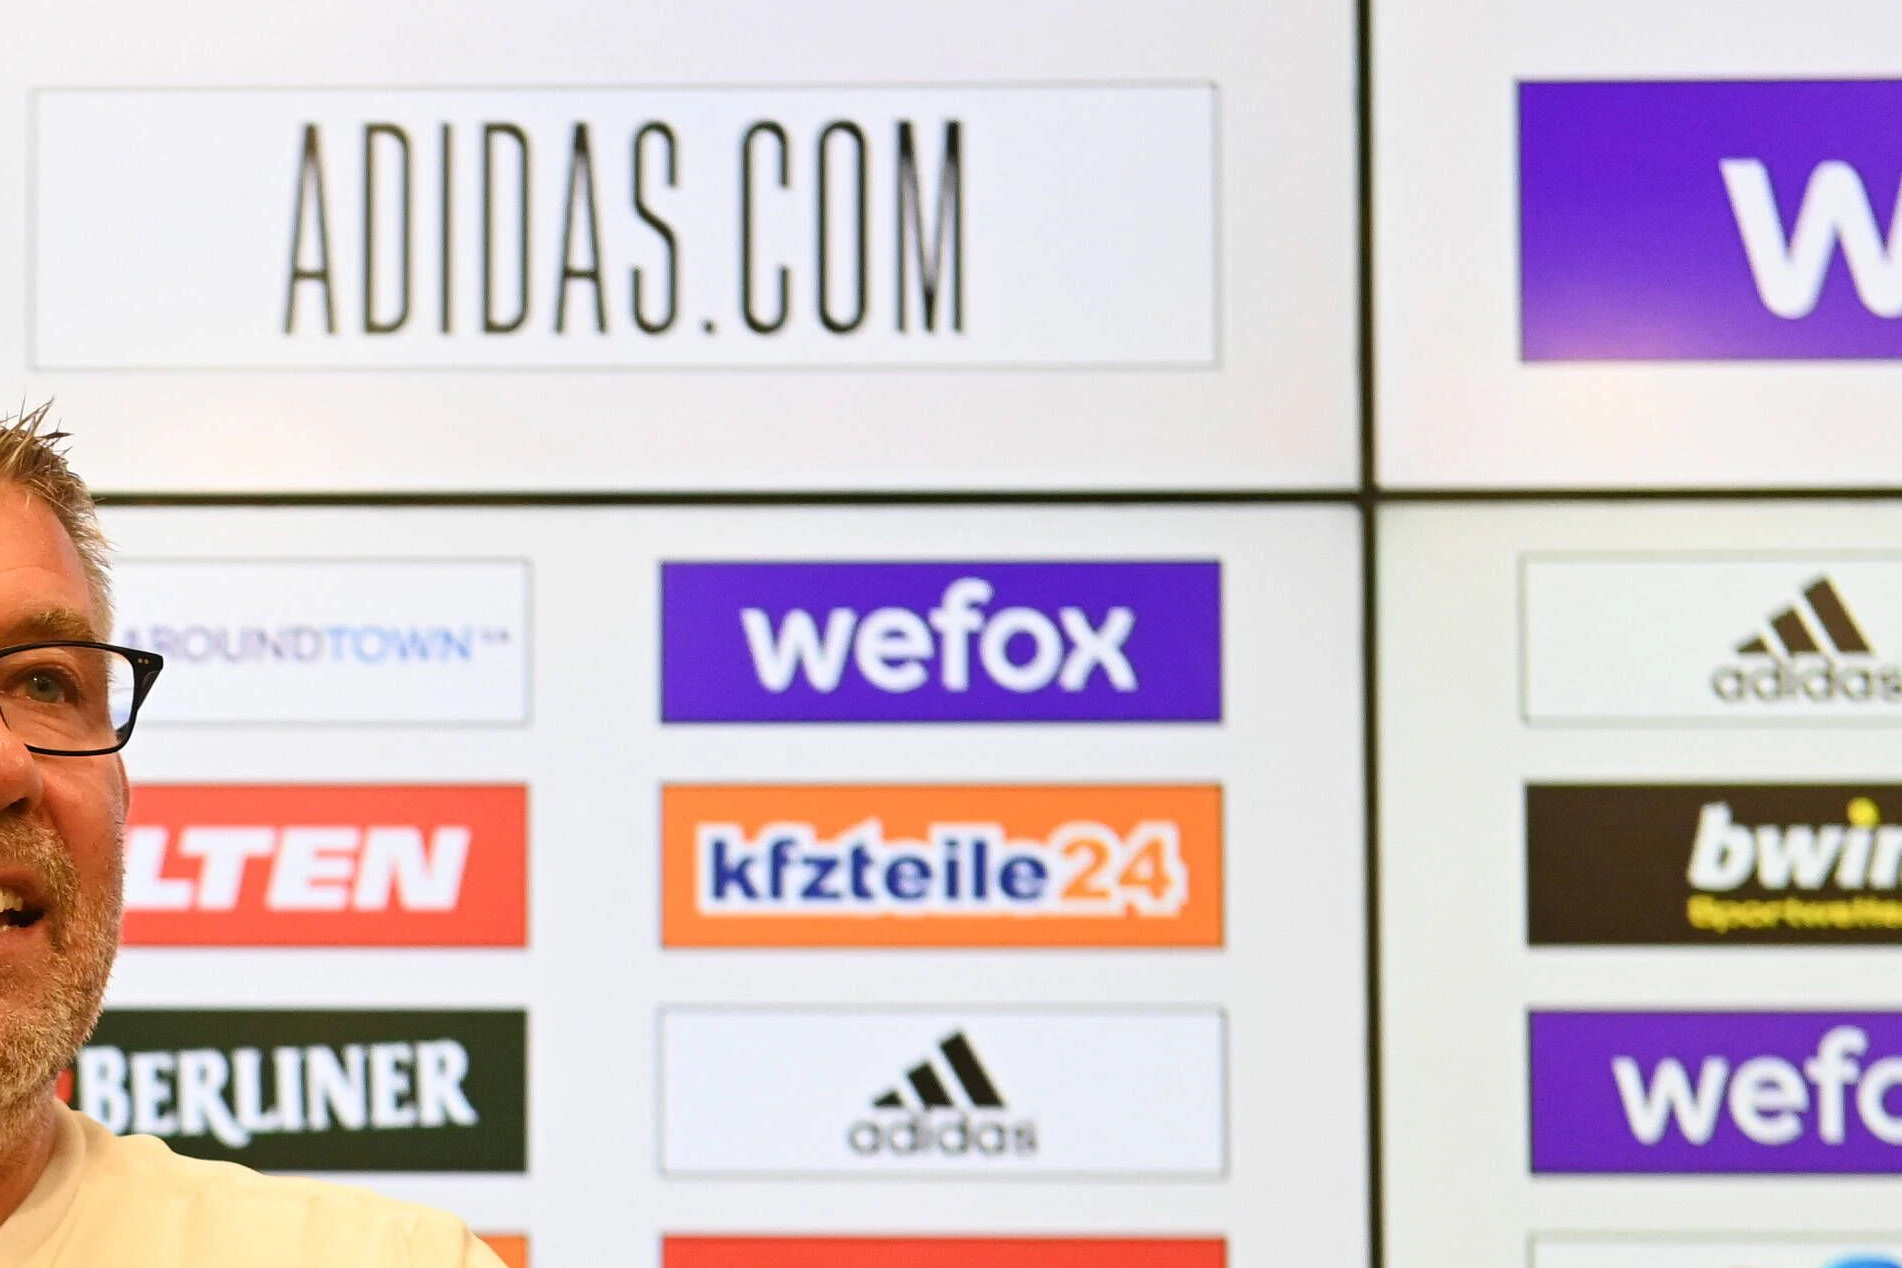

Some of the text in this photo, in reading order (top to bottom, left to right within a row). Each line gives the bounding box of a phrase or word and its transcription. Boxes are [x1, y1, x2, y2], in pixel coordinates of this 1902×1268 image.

[284, 120, 964, 334] ADIDAS.COM
[741, 578, 1137, 692] wefox
[125, 826, 472, 911] LTEN
[704, 832, 1178, 904] kfzteile24
[77, 1039, 478, 1148] BERLINER
[849, 1113, 1039, 1157] adidas
